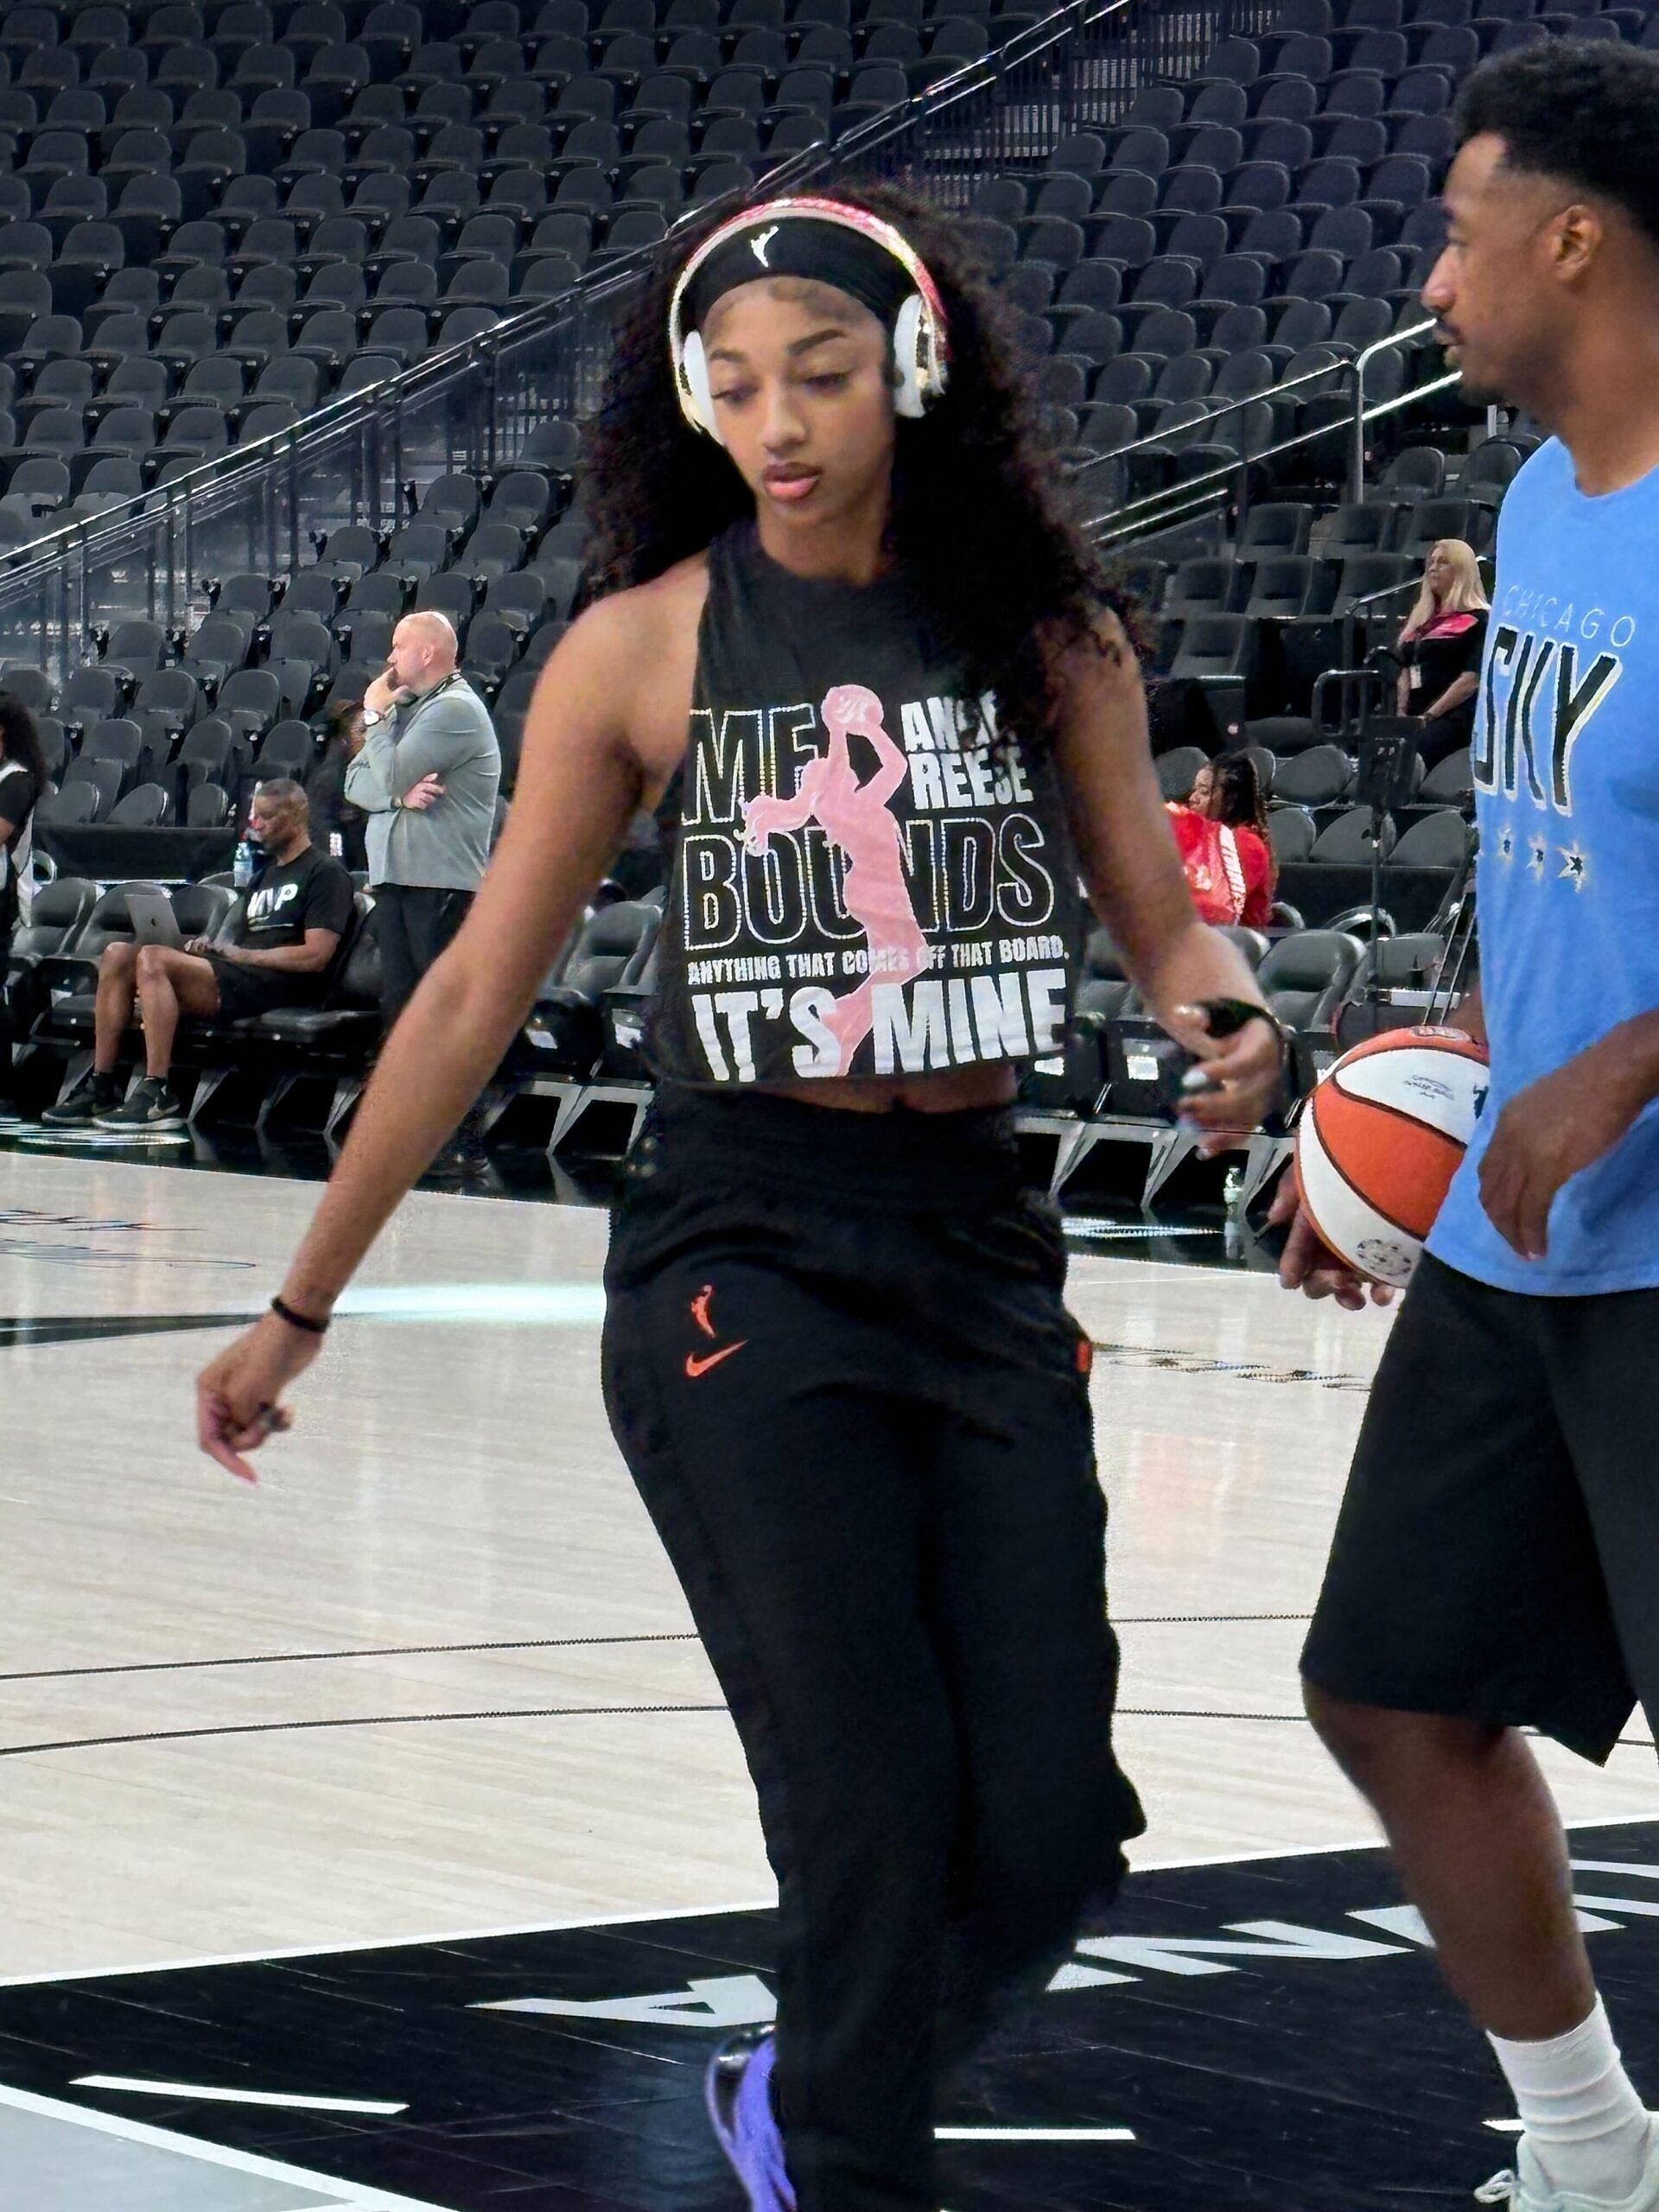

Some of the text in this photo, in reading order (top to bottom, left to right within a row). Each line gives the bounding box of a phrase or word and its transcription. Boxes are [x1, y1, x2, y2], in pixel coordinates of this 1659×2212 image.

[1502, 584, 1637, 648] CHICAGO
[1471, 622, 1623, 817] SKY
[907, 746, 1034, 810] REESE
[683, 813, 1055, 951] BOUNDS
[688, 956, 781, 986] ANYTHING
[786, 950, 835, 979] THAT
[951, 941, 993, 968] THAT
[999, 934, 1070, 963] BOARD.
[692, 968, 1068, 1084] IT'S MINE
